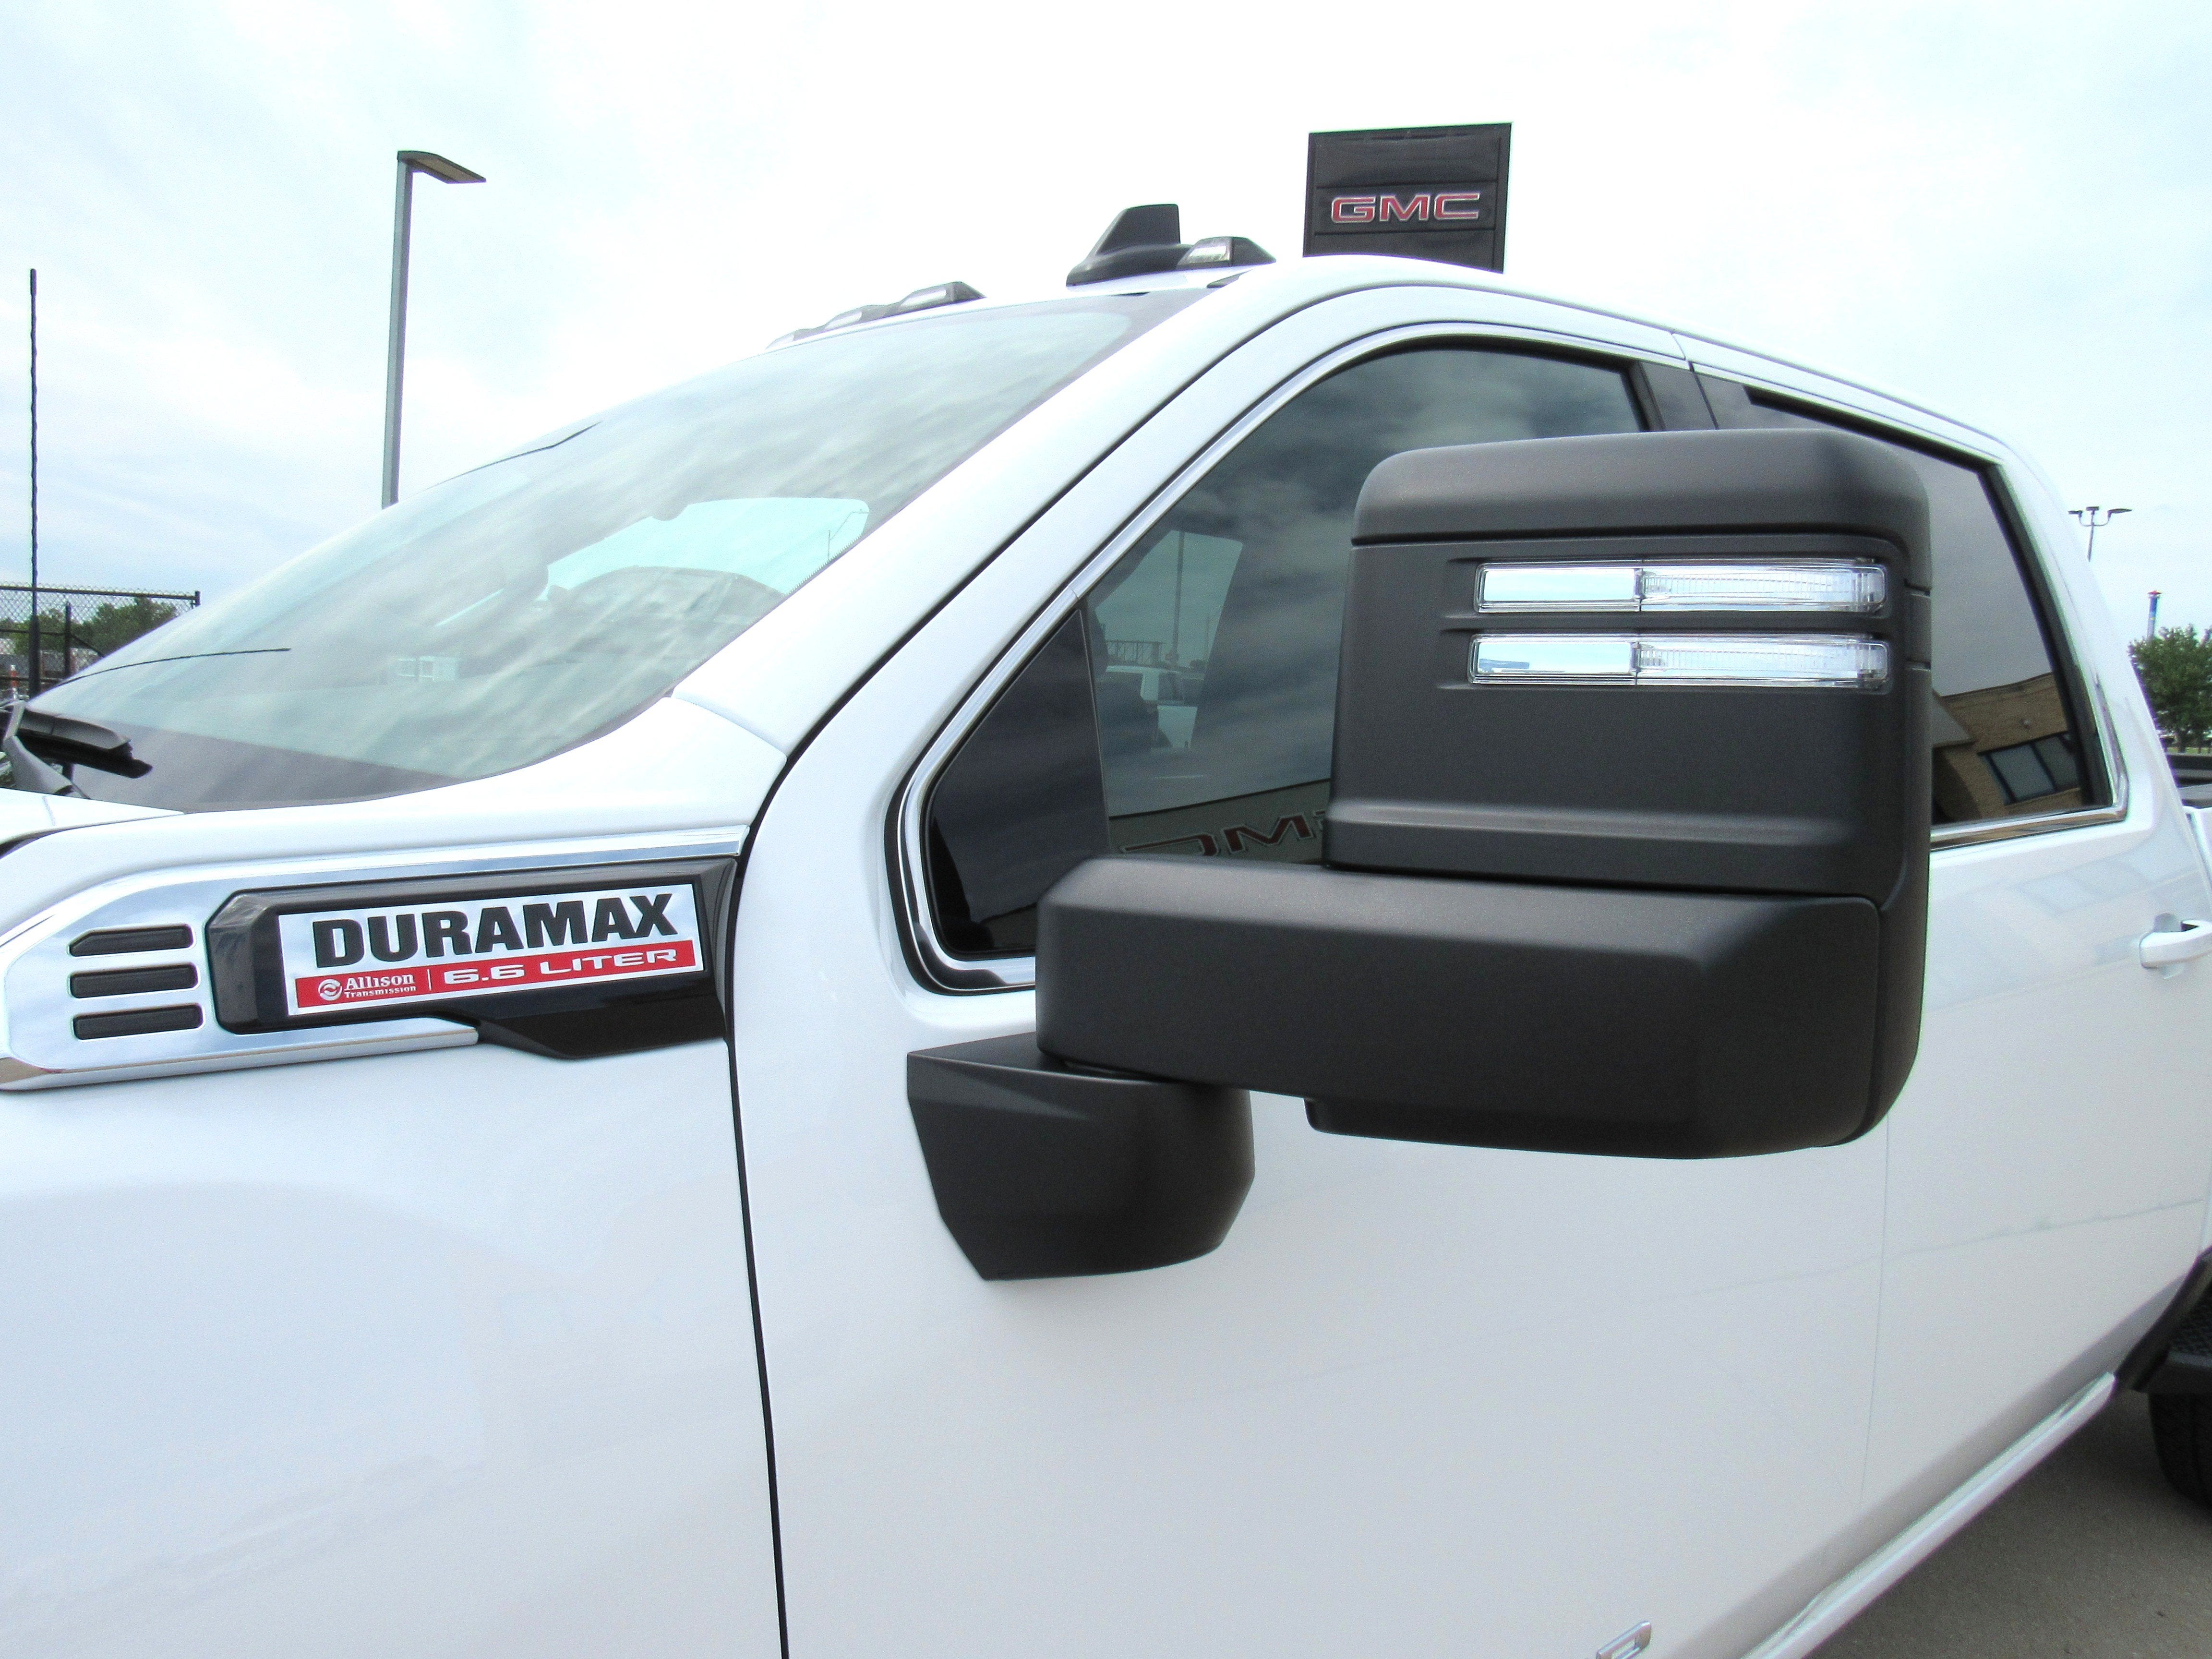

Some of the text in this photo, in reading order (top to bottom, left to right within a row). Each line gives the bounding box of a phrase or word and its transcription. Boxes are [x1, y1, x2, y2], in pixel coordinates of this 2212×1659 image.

[1331, 192, 1480, 223] GMC
[313, 893, 678, 968] DURAMAX
[346, 974, 415, 990] Allison
[444, 949, 677, 985] 6.6 LITER
[344, 986, 416, 998] Transmission
